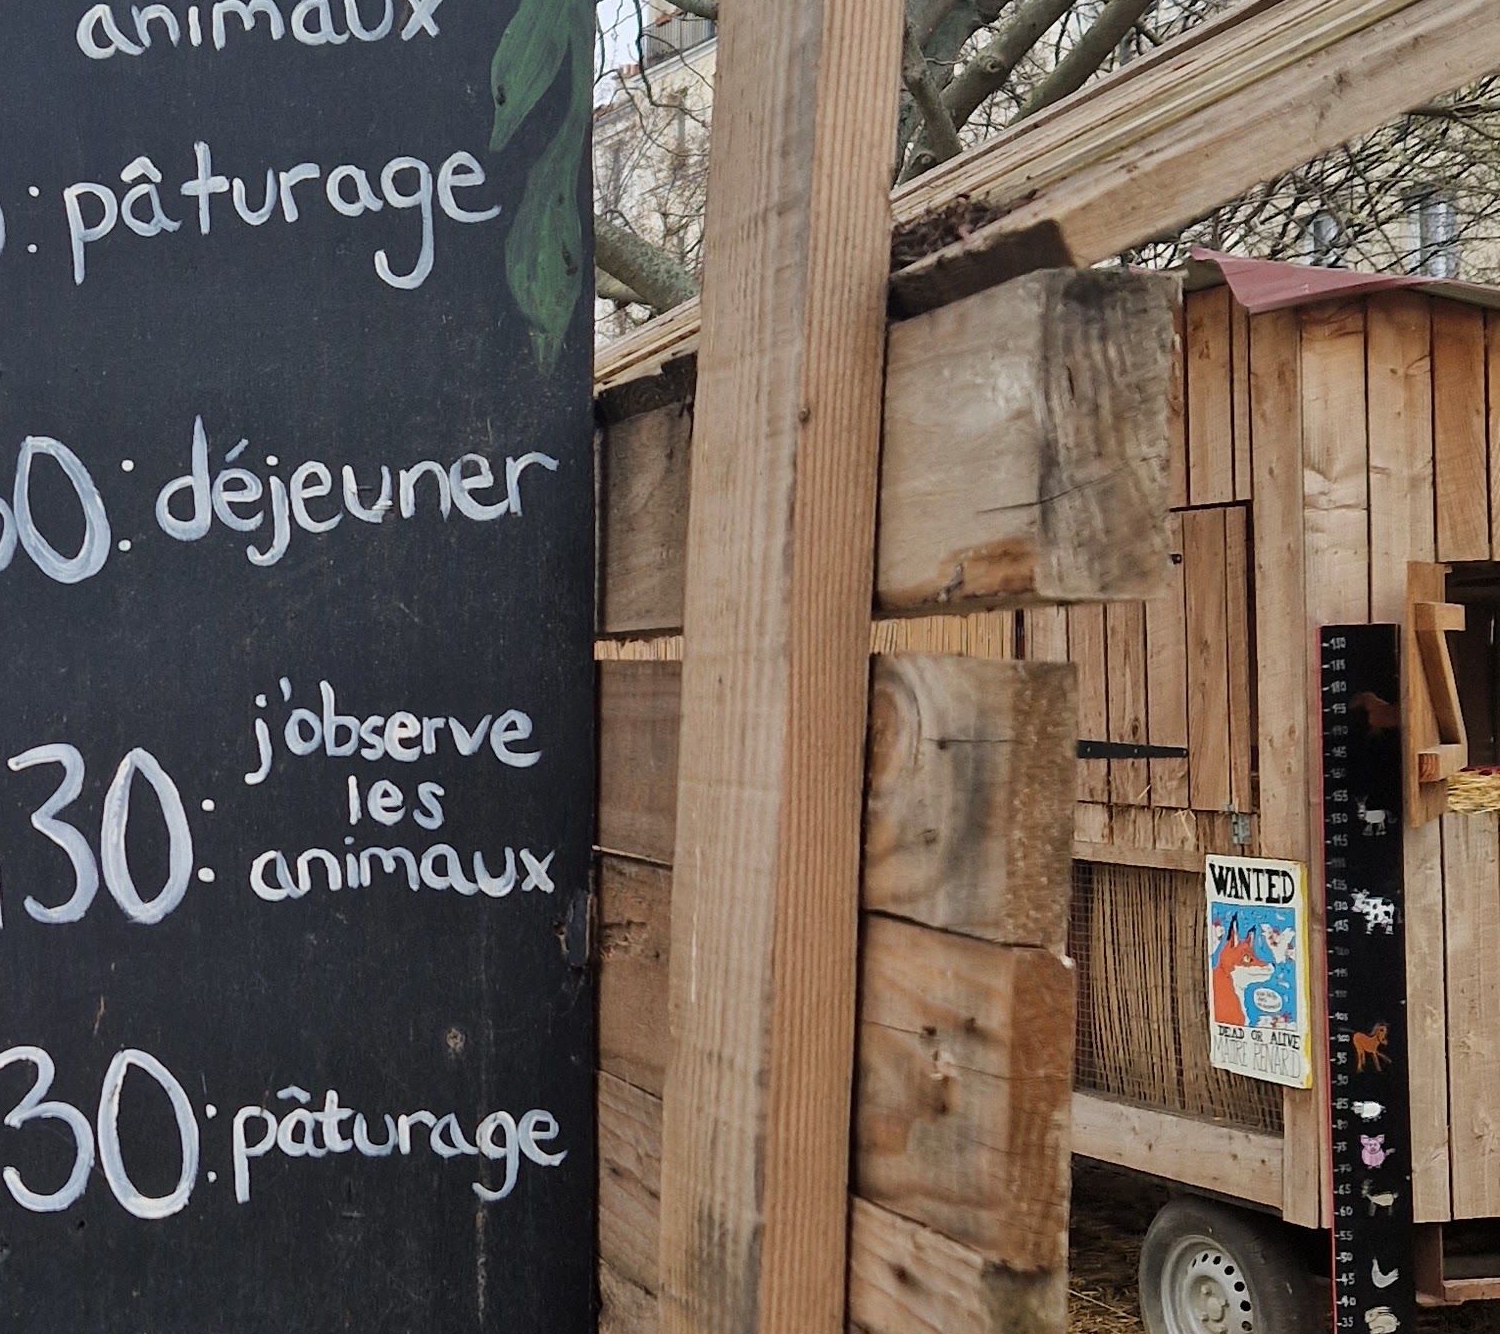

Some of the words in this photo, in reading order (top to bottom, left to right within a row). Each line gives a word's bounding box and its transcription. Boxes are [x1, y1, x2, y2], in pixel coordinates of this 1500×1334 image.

[63, 141, 501, 289] pâturage
[156, 415, 558, 566] déjeuner
[244, 677, 541, 785] j'observe
[348, 775, 445, 830] les
[250, 837, 556, 900] animaux
[1209, 863, 1296, 905] WANTED
[1218, 1025, 1245, 1040] DEAD
[1250, 1029, 1263, 1043] OR
[1270, 1031, 1301, 1051] ALIVE
[1253, 1042, 1301, 1079] RENARD
[233, 1086, 567, 1203] pâturage
